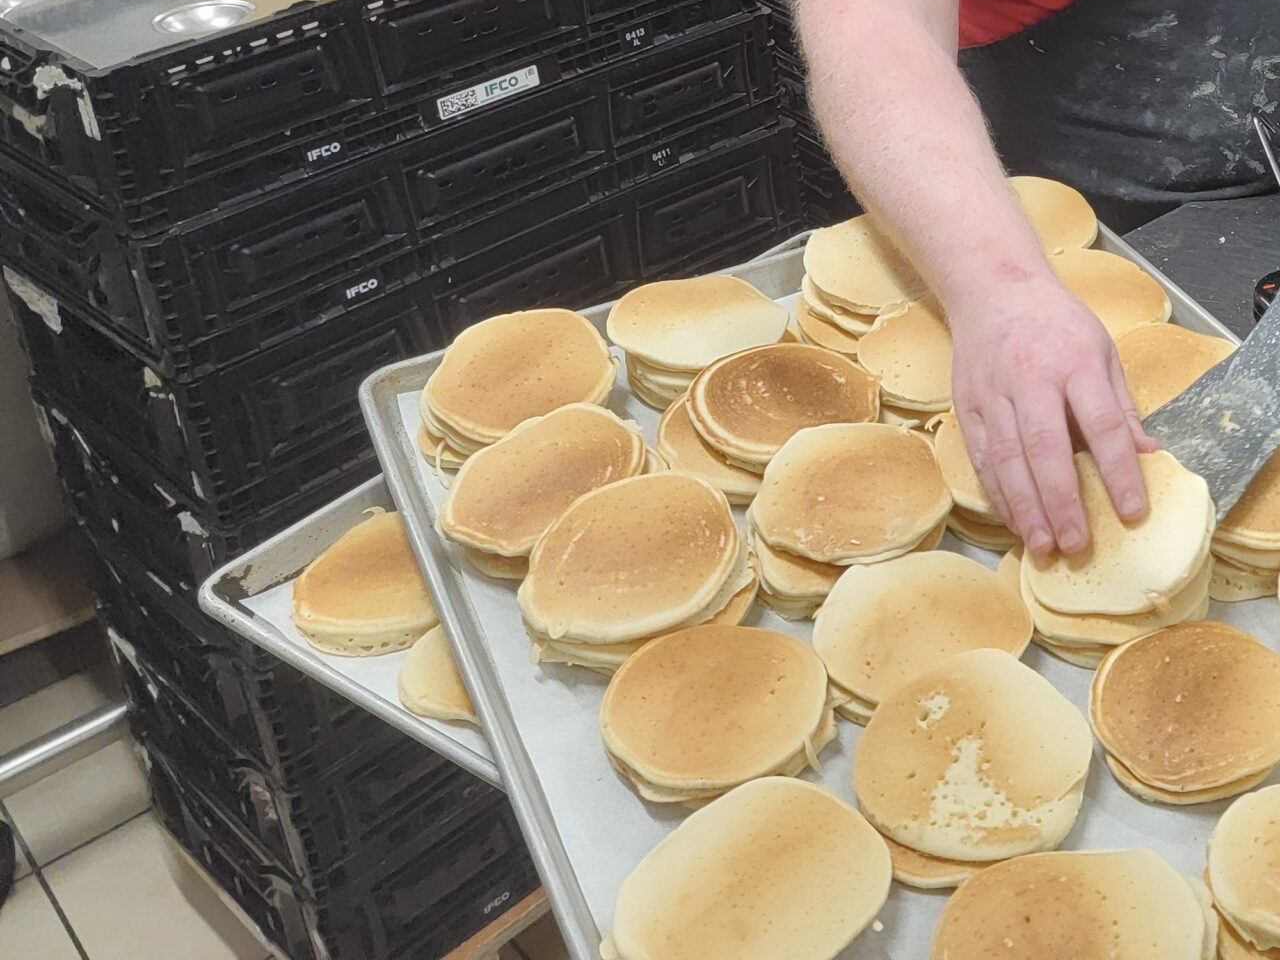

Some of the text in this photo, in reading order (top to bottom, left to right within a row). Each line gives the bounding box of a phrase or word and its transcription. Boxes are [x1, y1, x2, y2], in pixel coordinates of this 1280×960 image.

[625, 28, 645, 40] 6413
[484, 76, 519, 97] IFCO
[307, 142, 341, 161] IFCO
[652, 147, 671, 161] 6411
[346, 278, 378, 299] IFCO
[483, 891, 511, 914] IFCO
